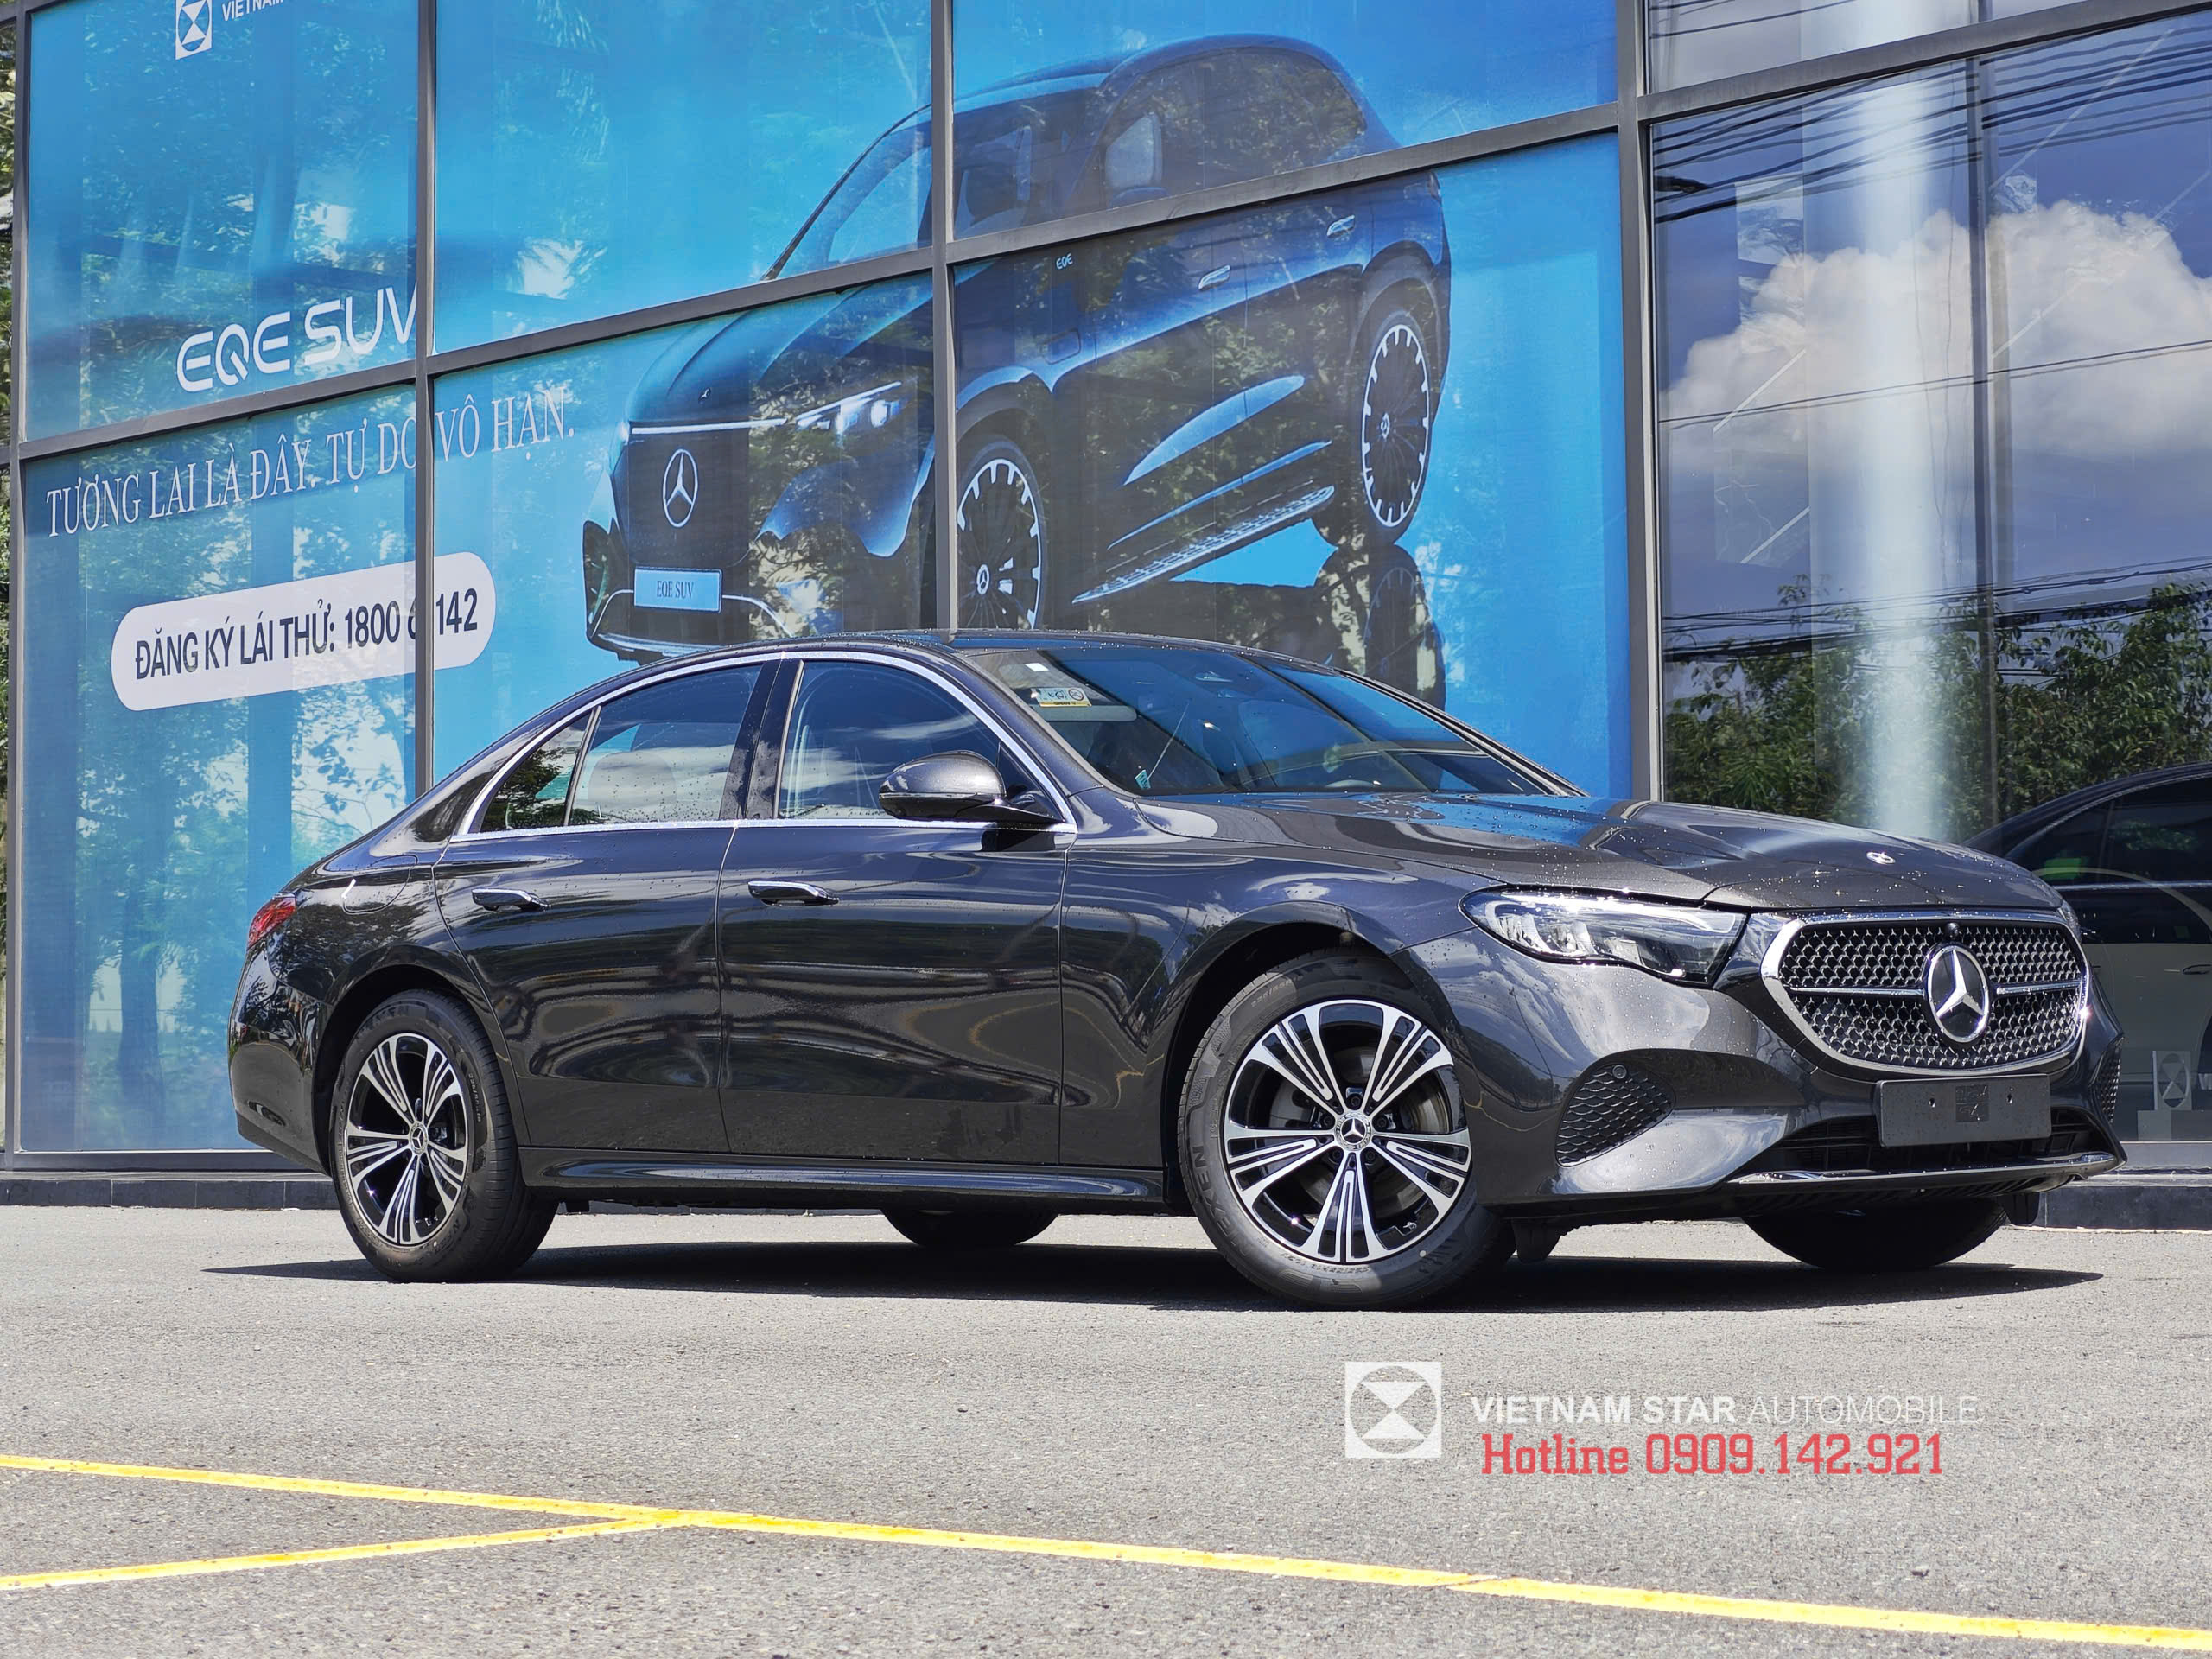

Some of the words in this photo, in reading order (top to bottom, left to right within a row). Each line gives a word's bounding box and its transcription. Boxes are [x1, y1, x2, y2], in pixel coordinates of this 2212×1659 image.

[222, 0, 283, 22] VIETN
[176, 311, 291, 392] EQE
[304, 282, 417, 365] SUV
[46, 474, 141, 537] TƯƠNG
[149, 462, 197, 519] LAI
[205, 442, 243, 509] LÀ
[250, 433, 316, 500] ĐÂY.
[326, 417, 368, 493] TỰ
[435, 393, 480, 462] VÔ
[491, 385, 575, 461] HẠN.
[675, 582, 695, 600] SUV
[135, 627, 199, 680] ĐĂNG
[205, 615, 235, 671] KÝ
[240, 610, 274, 665] LÁI
[279, 598, 335, 659] THỬ:
[345, 601, 401, 649] 1800
